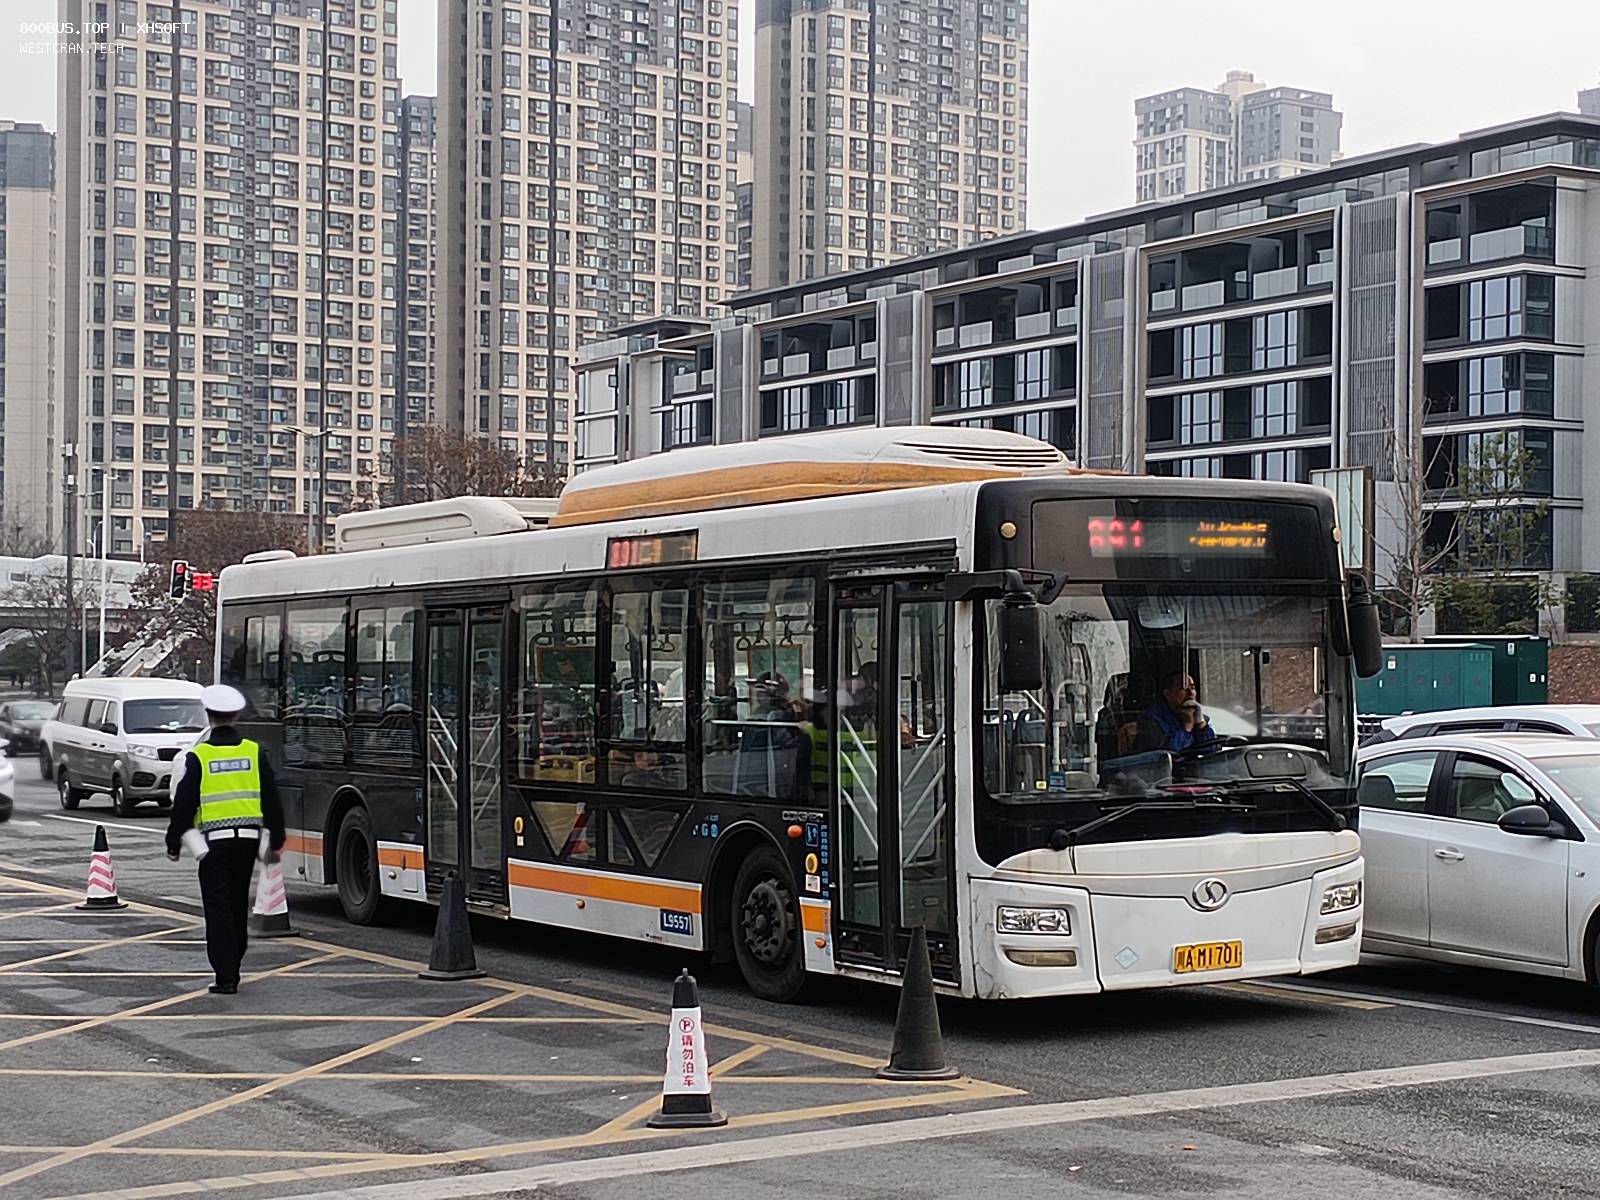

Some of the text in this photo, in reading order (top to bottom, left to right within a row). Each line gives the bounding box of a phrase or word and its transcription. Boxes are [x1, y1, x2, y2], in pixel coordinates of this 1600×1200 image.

[663, 912, 689, 931] L9557
[681, 1034, 695, 1088] 请勿泊车
